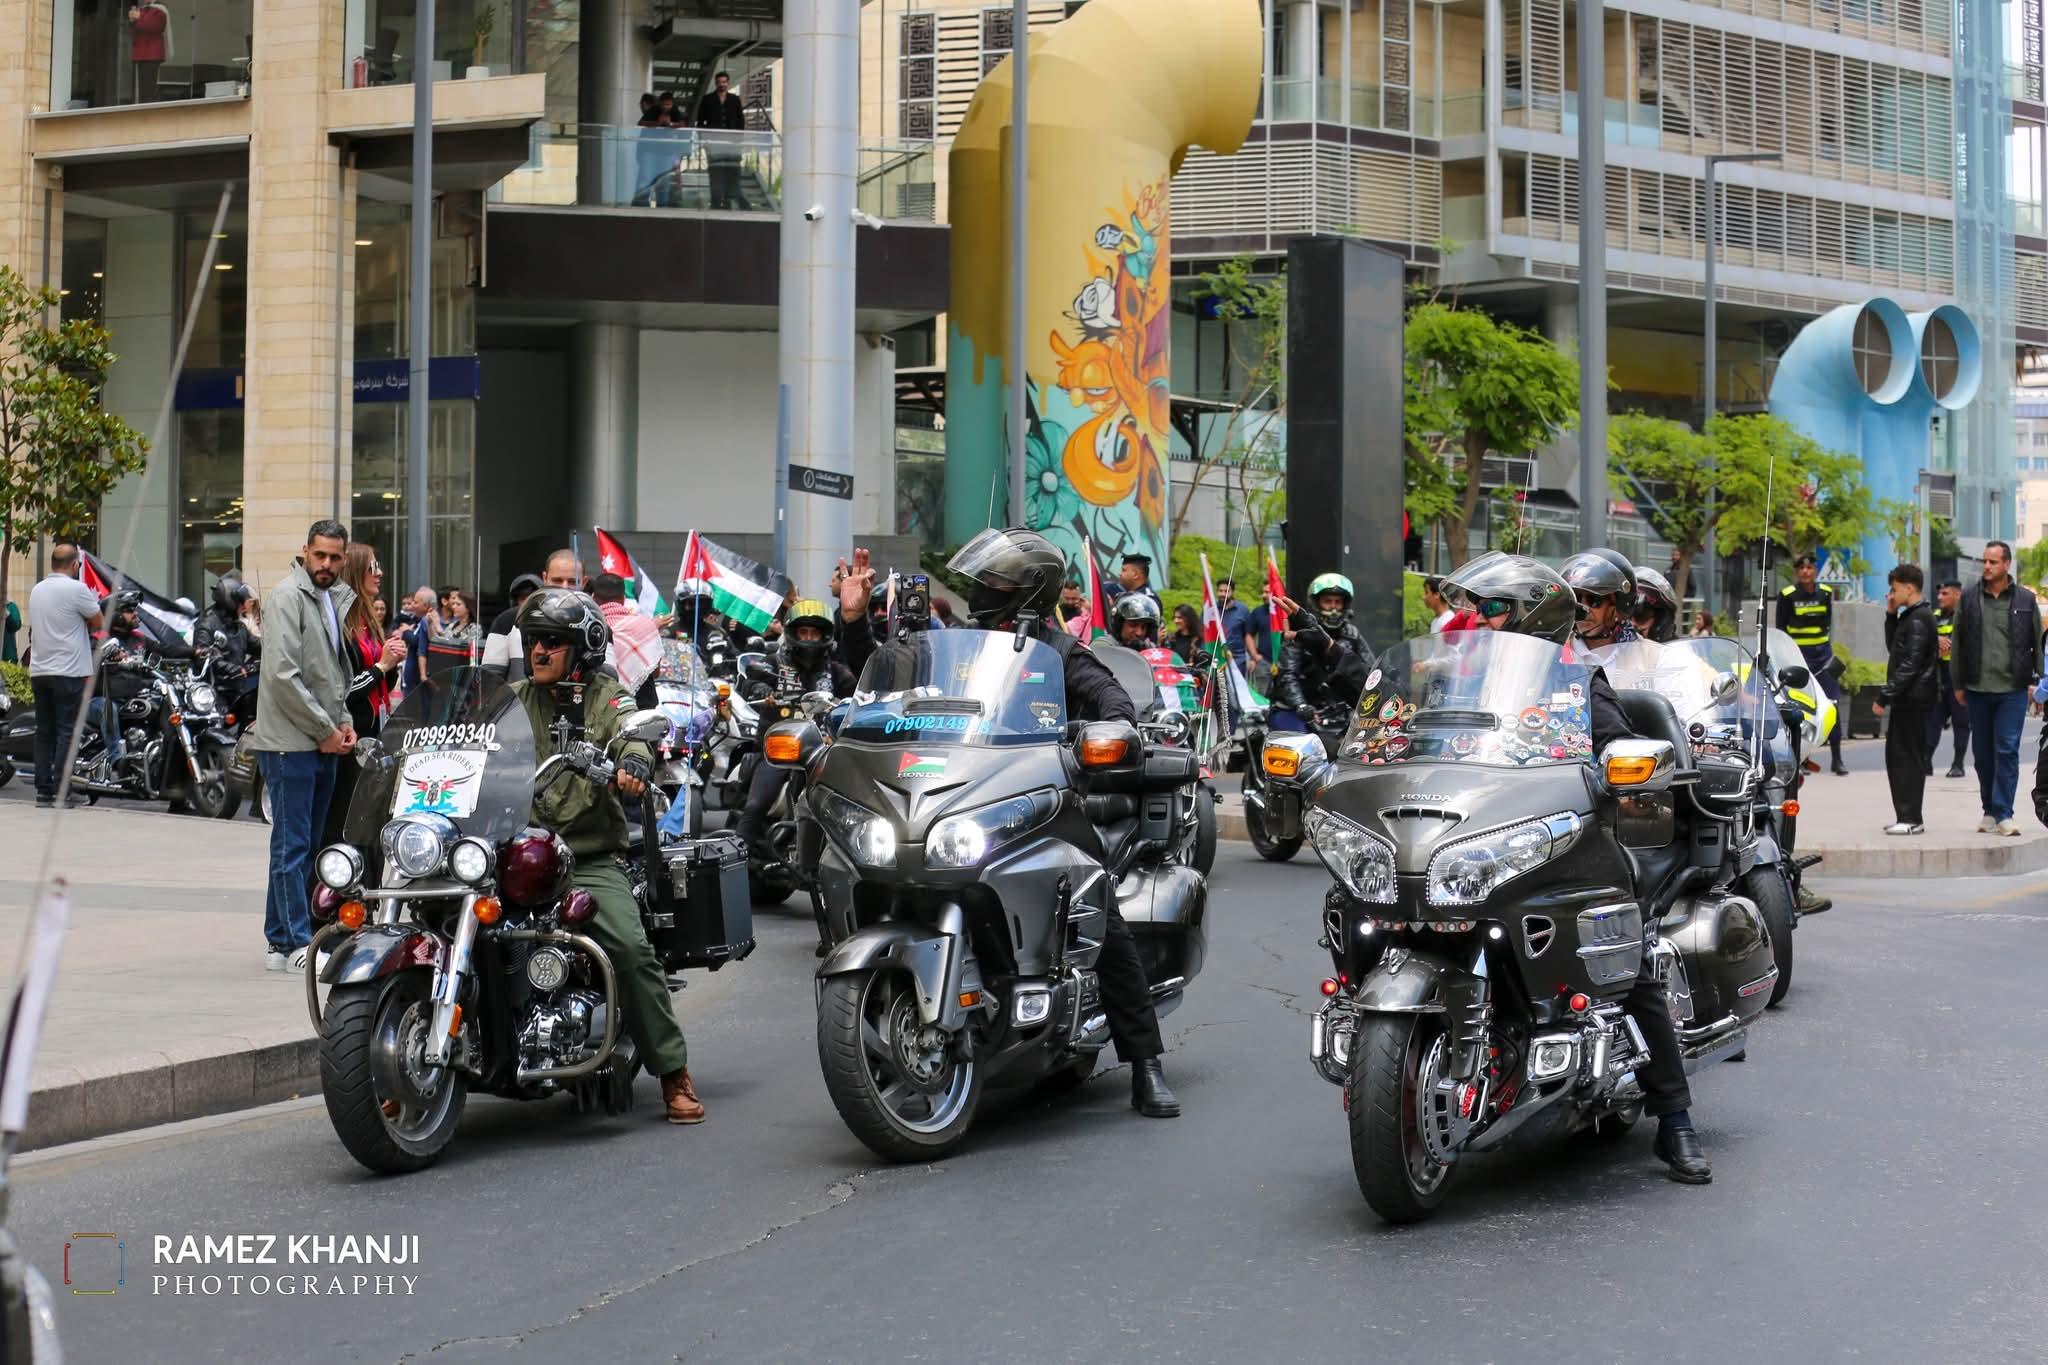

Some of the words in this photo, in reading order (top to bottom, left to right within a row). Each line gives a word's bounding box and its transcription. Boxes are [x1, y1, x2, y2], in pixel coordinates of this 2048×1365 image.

[404, 723, 496, 748] 0799929340
[885, 715, 991, 735] 079021498
[408, 755, 430, 773] DEAD
[432, 752, 446, 760] SEA
[448, 751, 474, 772] RIDERS
[1400, 793, 1453, 801] HONDA
